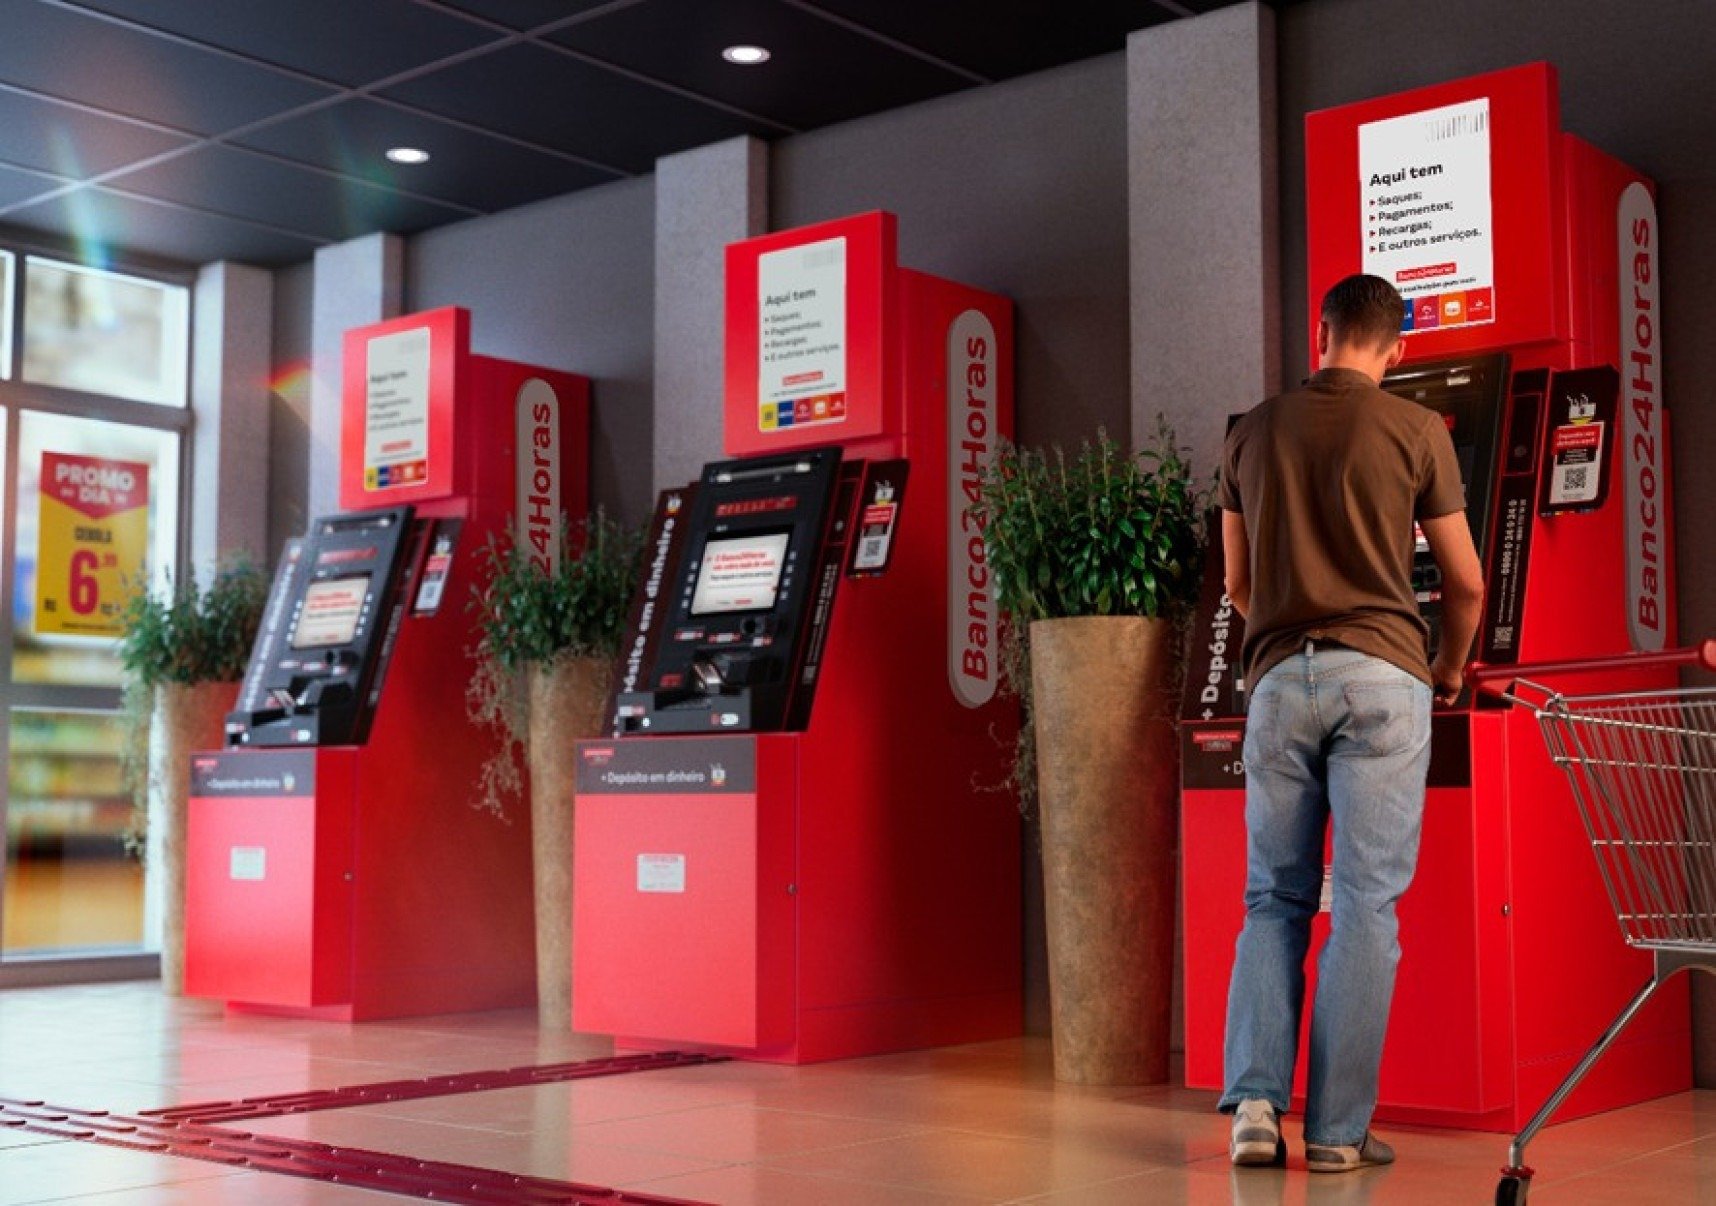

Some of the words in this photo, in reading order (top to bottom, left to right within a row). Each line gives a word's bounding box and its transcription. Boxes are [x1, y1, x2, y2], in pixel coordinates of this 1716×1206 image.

[1369, 168, 1406, 186] Aqui
[1409, 162, 1444, 179] tem
[1378, 190, 1423, 206] Saques;
[1378, 200, 1454, 222] Pagamentos;
[1378, 220, 1433, 237] Recargas;
[1378, 242, 1386, 252] E
[1388, 235, 1428, 251] outros
[1430, 227, 1482, 245] serviços.
[765, 291, 790, 306] Aqui
[793, 288, 816, 301] tem
[1632, 217, 1659, 632] Banco24Horas
[55, 462, 135, 492] PROMO
[78, 487, 111, 505] DIA
[528, 402, 551, 578] 24Horas
[645, 517, 675, 598] dinheiro
[70, 548, 100, 616] 6
[650, 773, 665, 783] em
[666, 769, 706, 783] dinheiro
